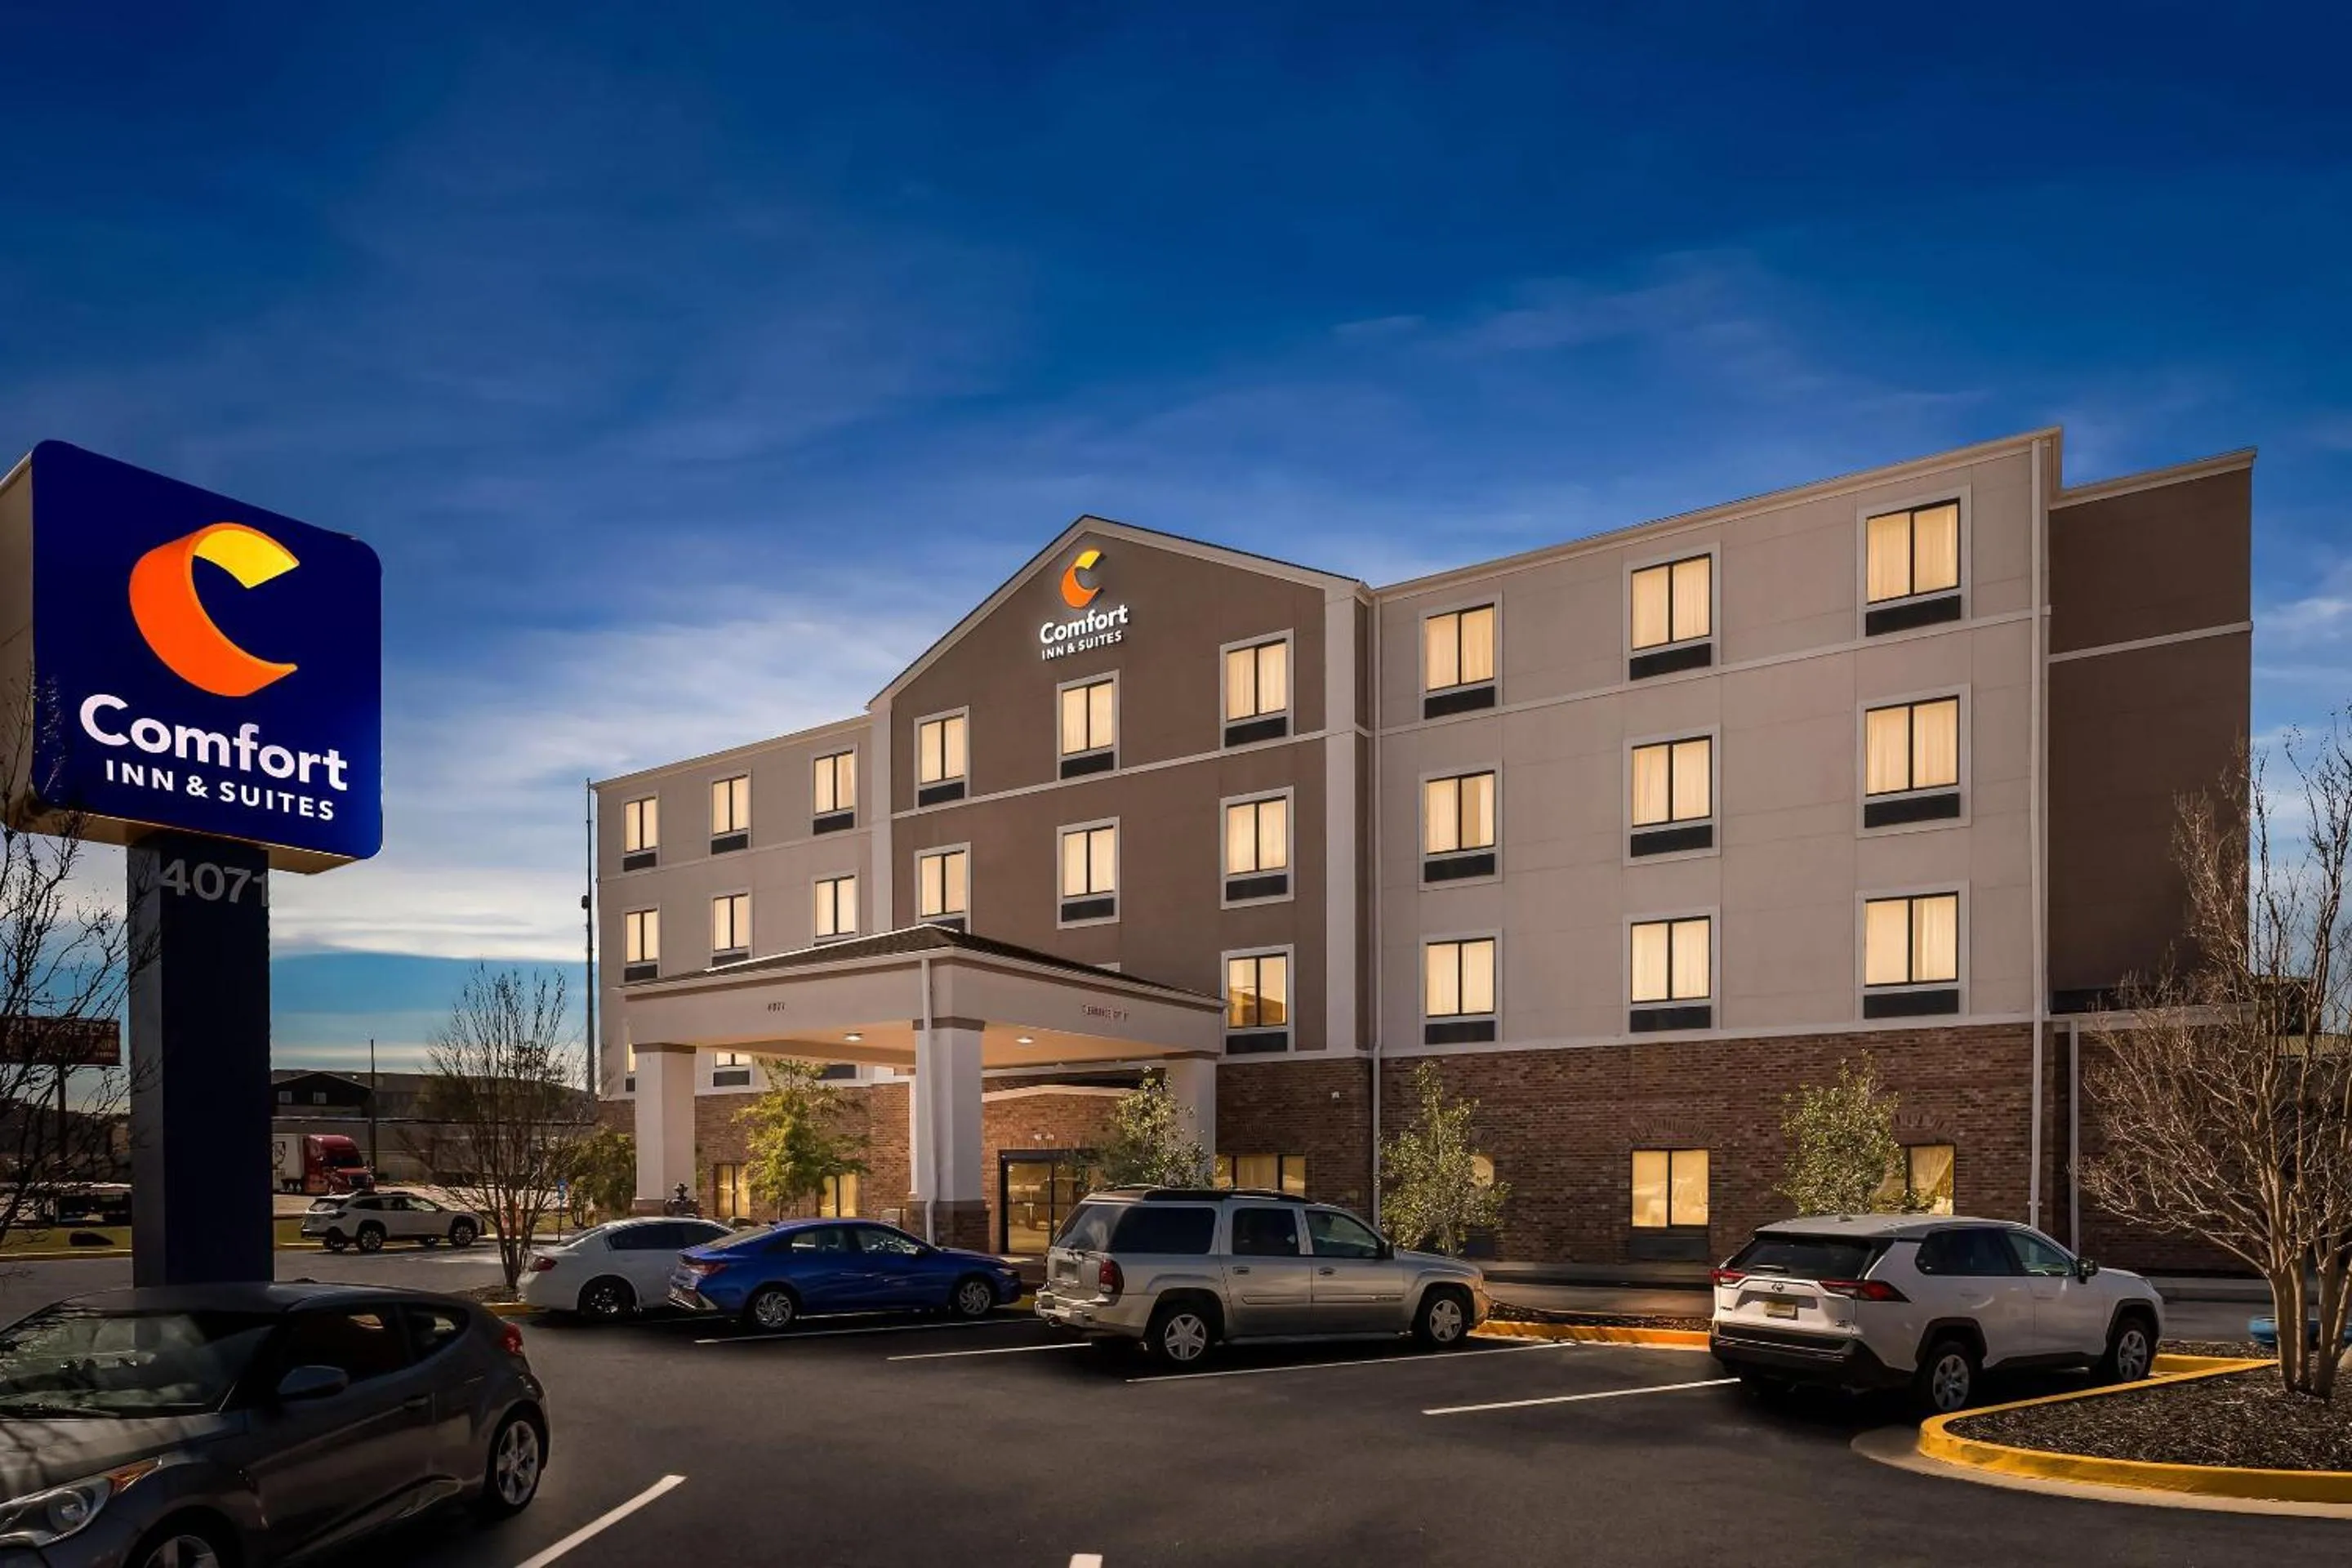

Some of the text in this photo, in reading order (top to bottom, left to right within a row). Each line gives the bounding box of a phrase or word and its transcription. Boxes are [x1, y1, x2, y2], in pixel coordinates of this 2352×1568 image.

[1040, 604, 1128, 644] Comfort
[1042, 630, 1122, 660] INN & SUITES
[80, 693, 347, 791] Comfort
[105, 760, 334, 821] INN & SUITES
[160, 859, 269, 907] 4071
